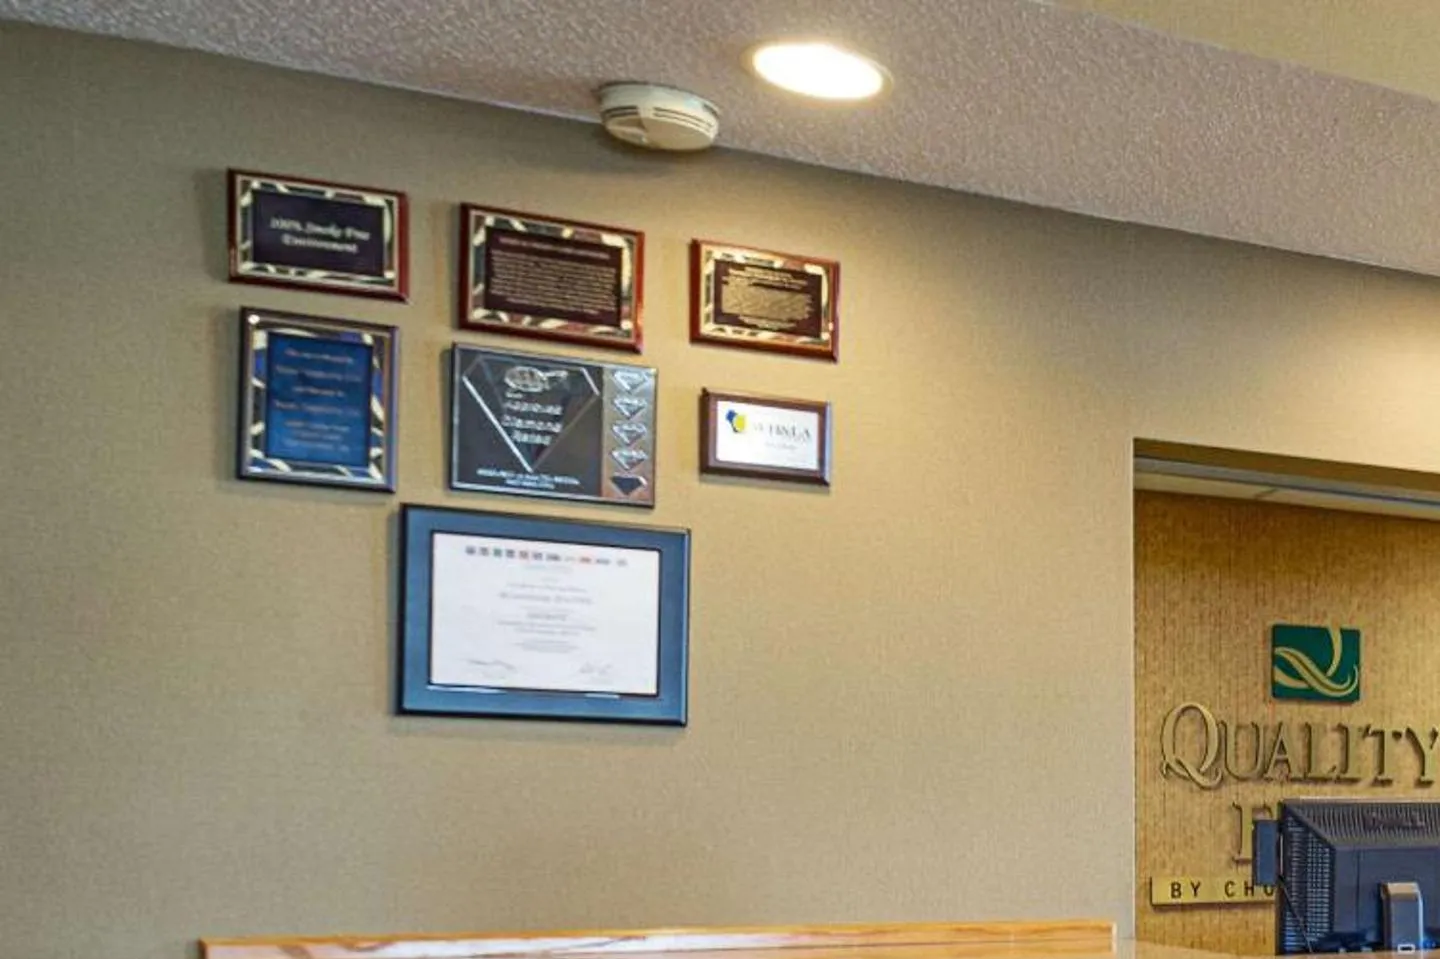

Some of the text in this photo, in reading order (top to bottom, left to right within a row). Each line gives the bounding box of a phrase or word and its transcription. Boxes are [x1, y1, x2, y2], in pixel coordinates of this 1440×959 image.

[1160, 702, 1440, 789] QUALITY
[1170, 880, 1274, 899] BY CHO
